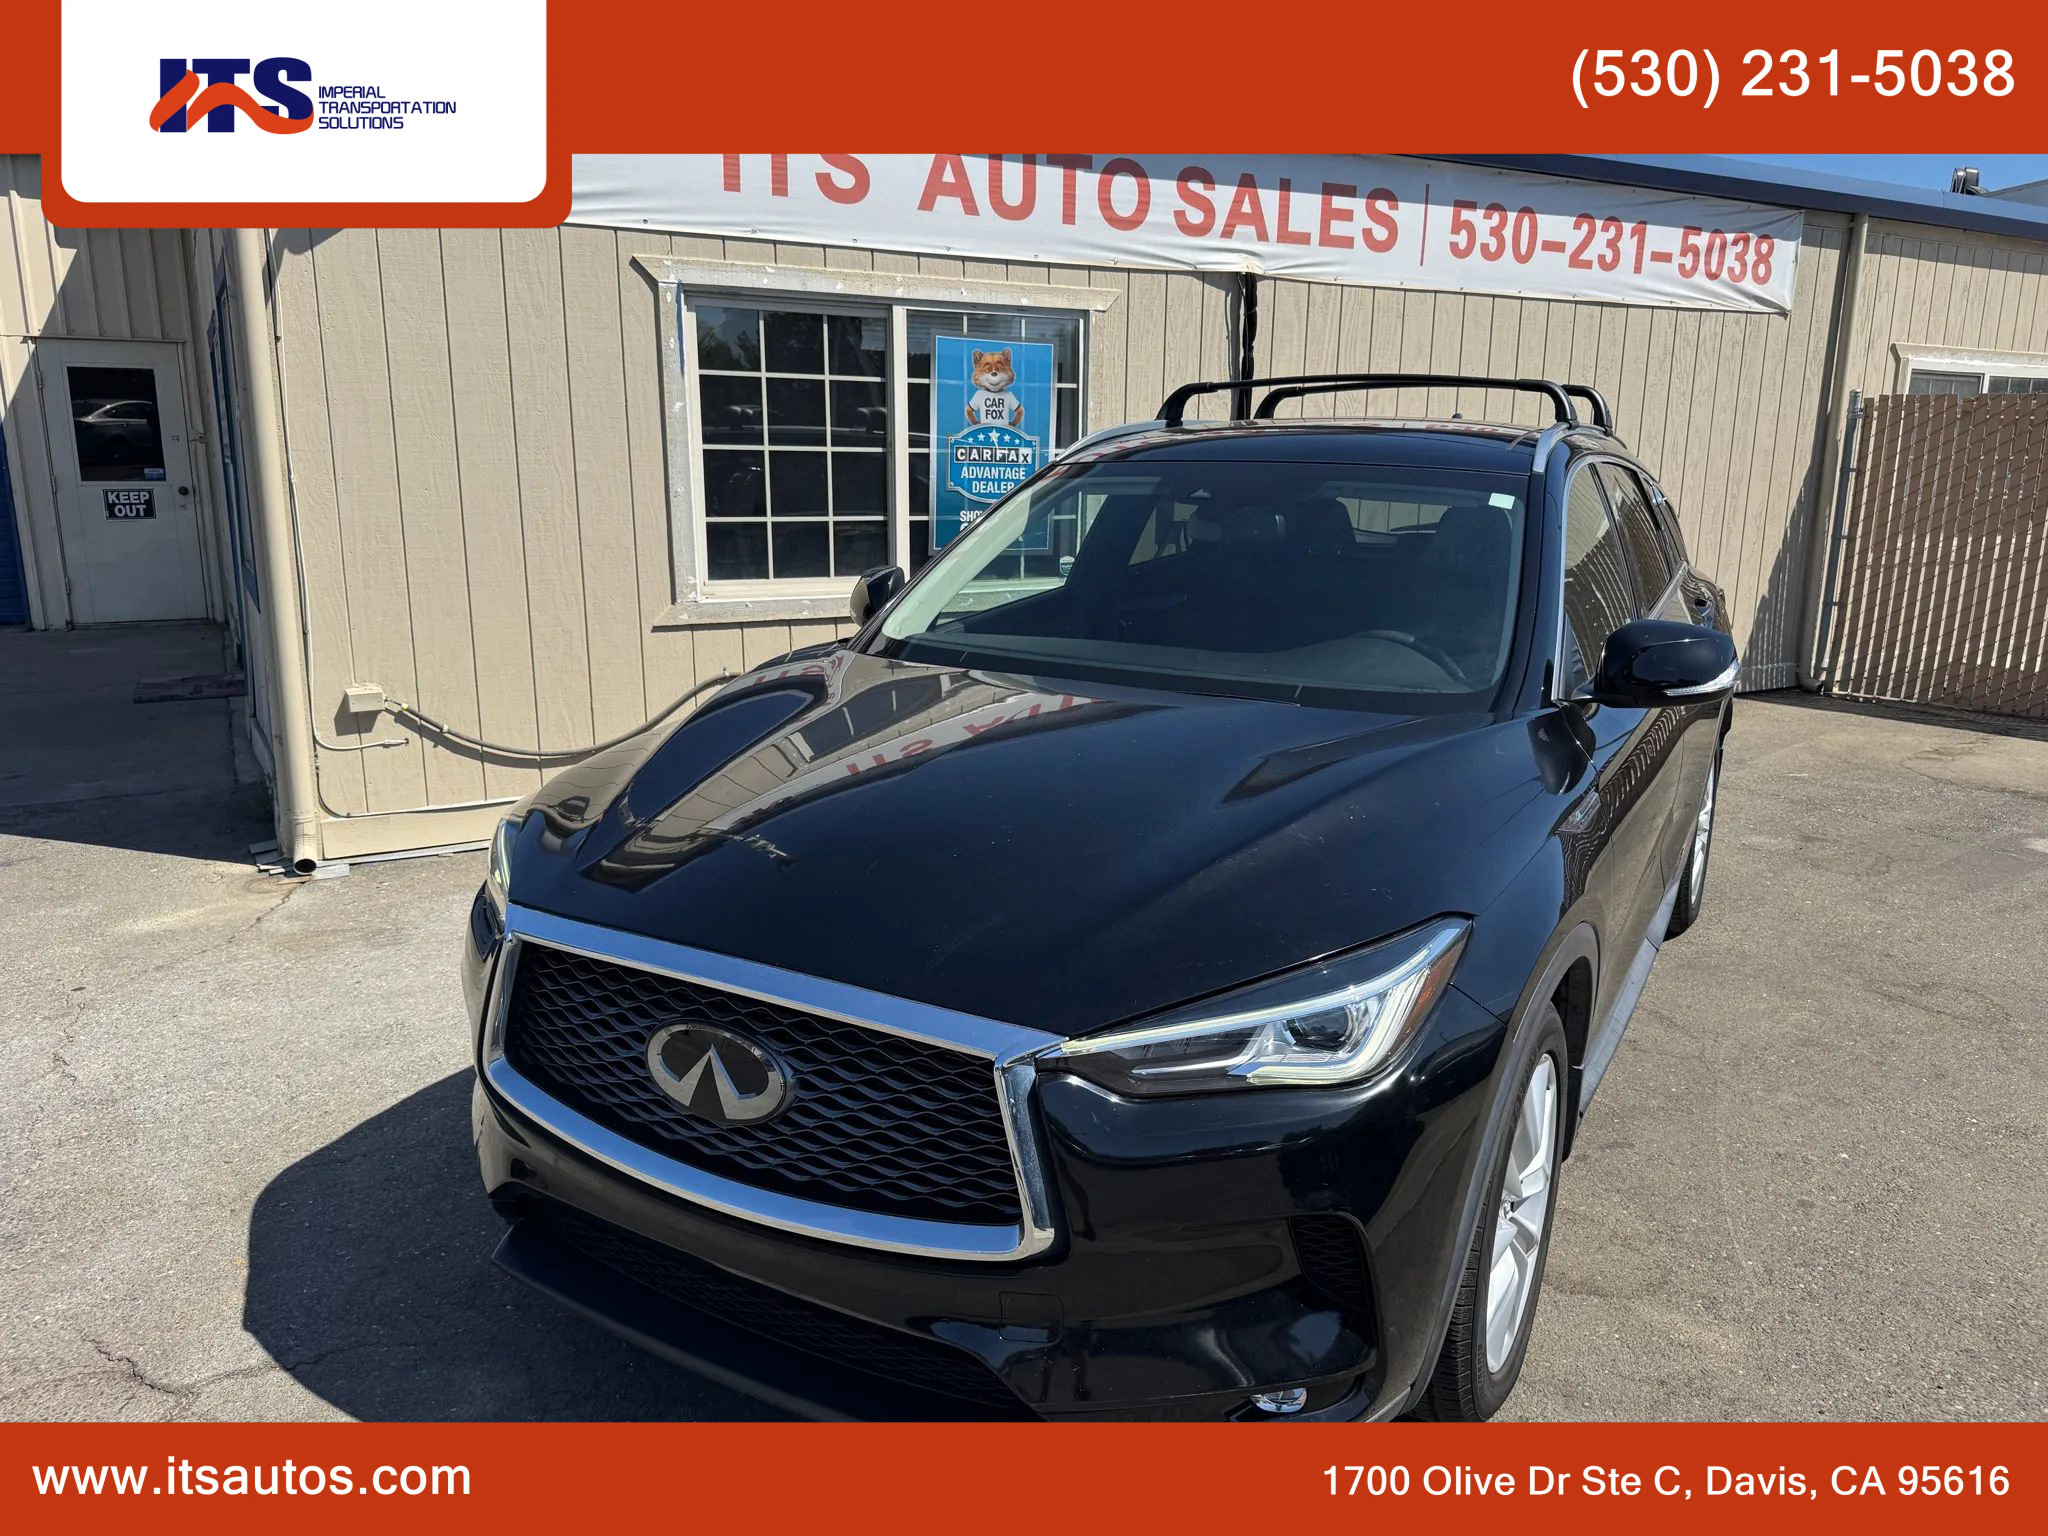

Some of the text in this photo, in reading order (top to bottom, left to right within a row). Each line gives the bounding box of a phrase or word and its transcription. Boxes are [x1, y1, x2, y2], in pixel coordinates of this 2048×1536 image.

[917, 154, 1152, 231] AUTO
[1174, 166, 1399, 253] SALES
[1449, 200, 1775, 285] 530-231-5038
[984, 398, 1005, 408] CAR
[985, 409, 1004, 420] FOX
[957, 448, 1029, 463] CARFAX
[961, 466, 1026, 480] ADVANTAGE
[972, 480, 1015, 494] DEALER
[107, 491, 150, 504] KEEP
[114, 504, 147, 517] OUT
